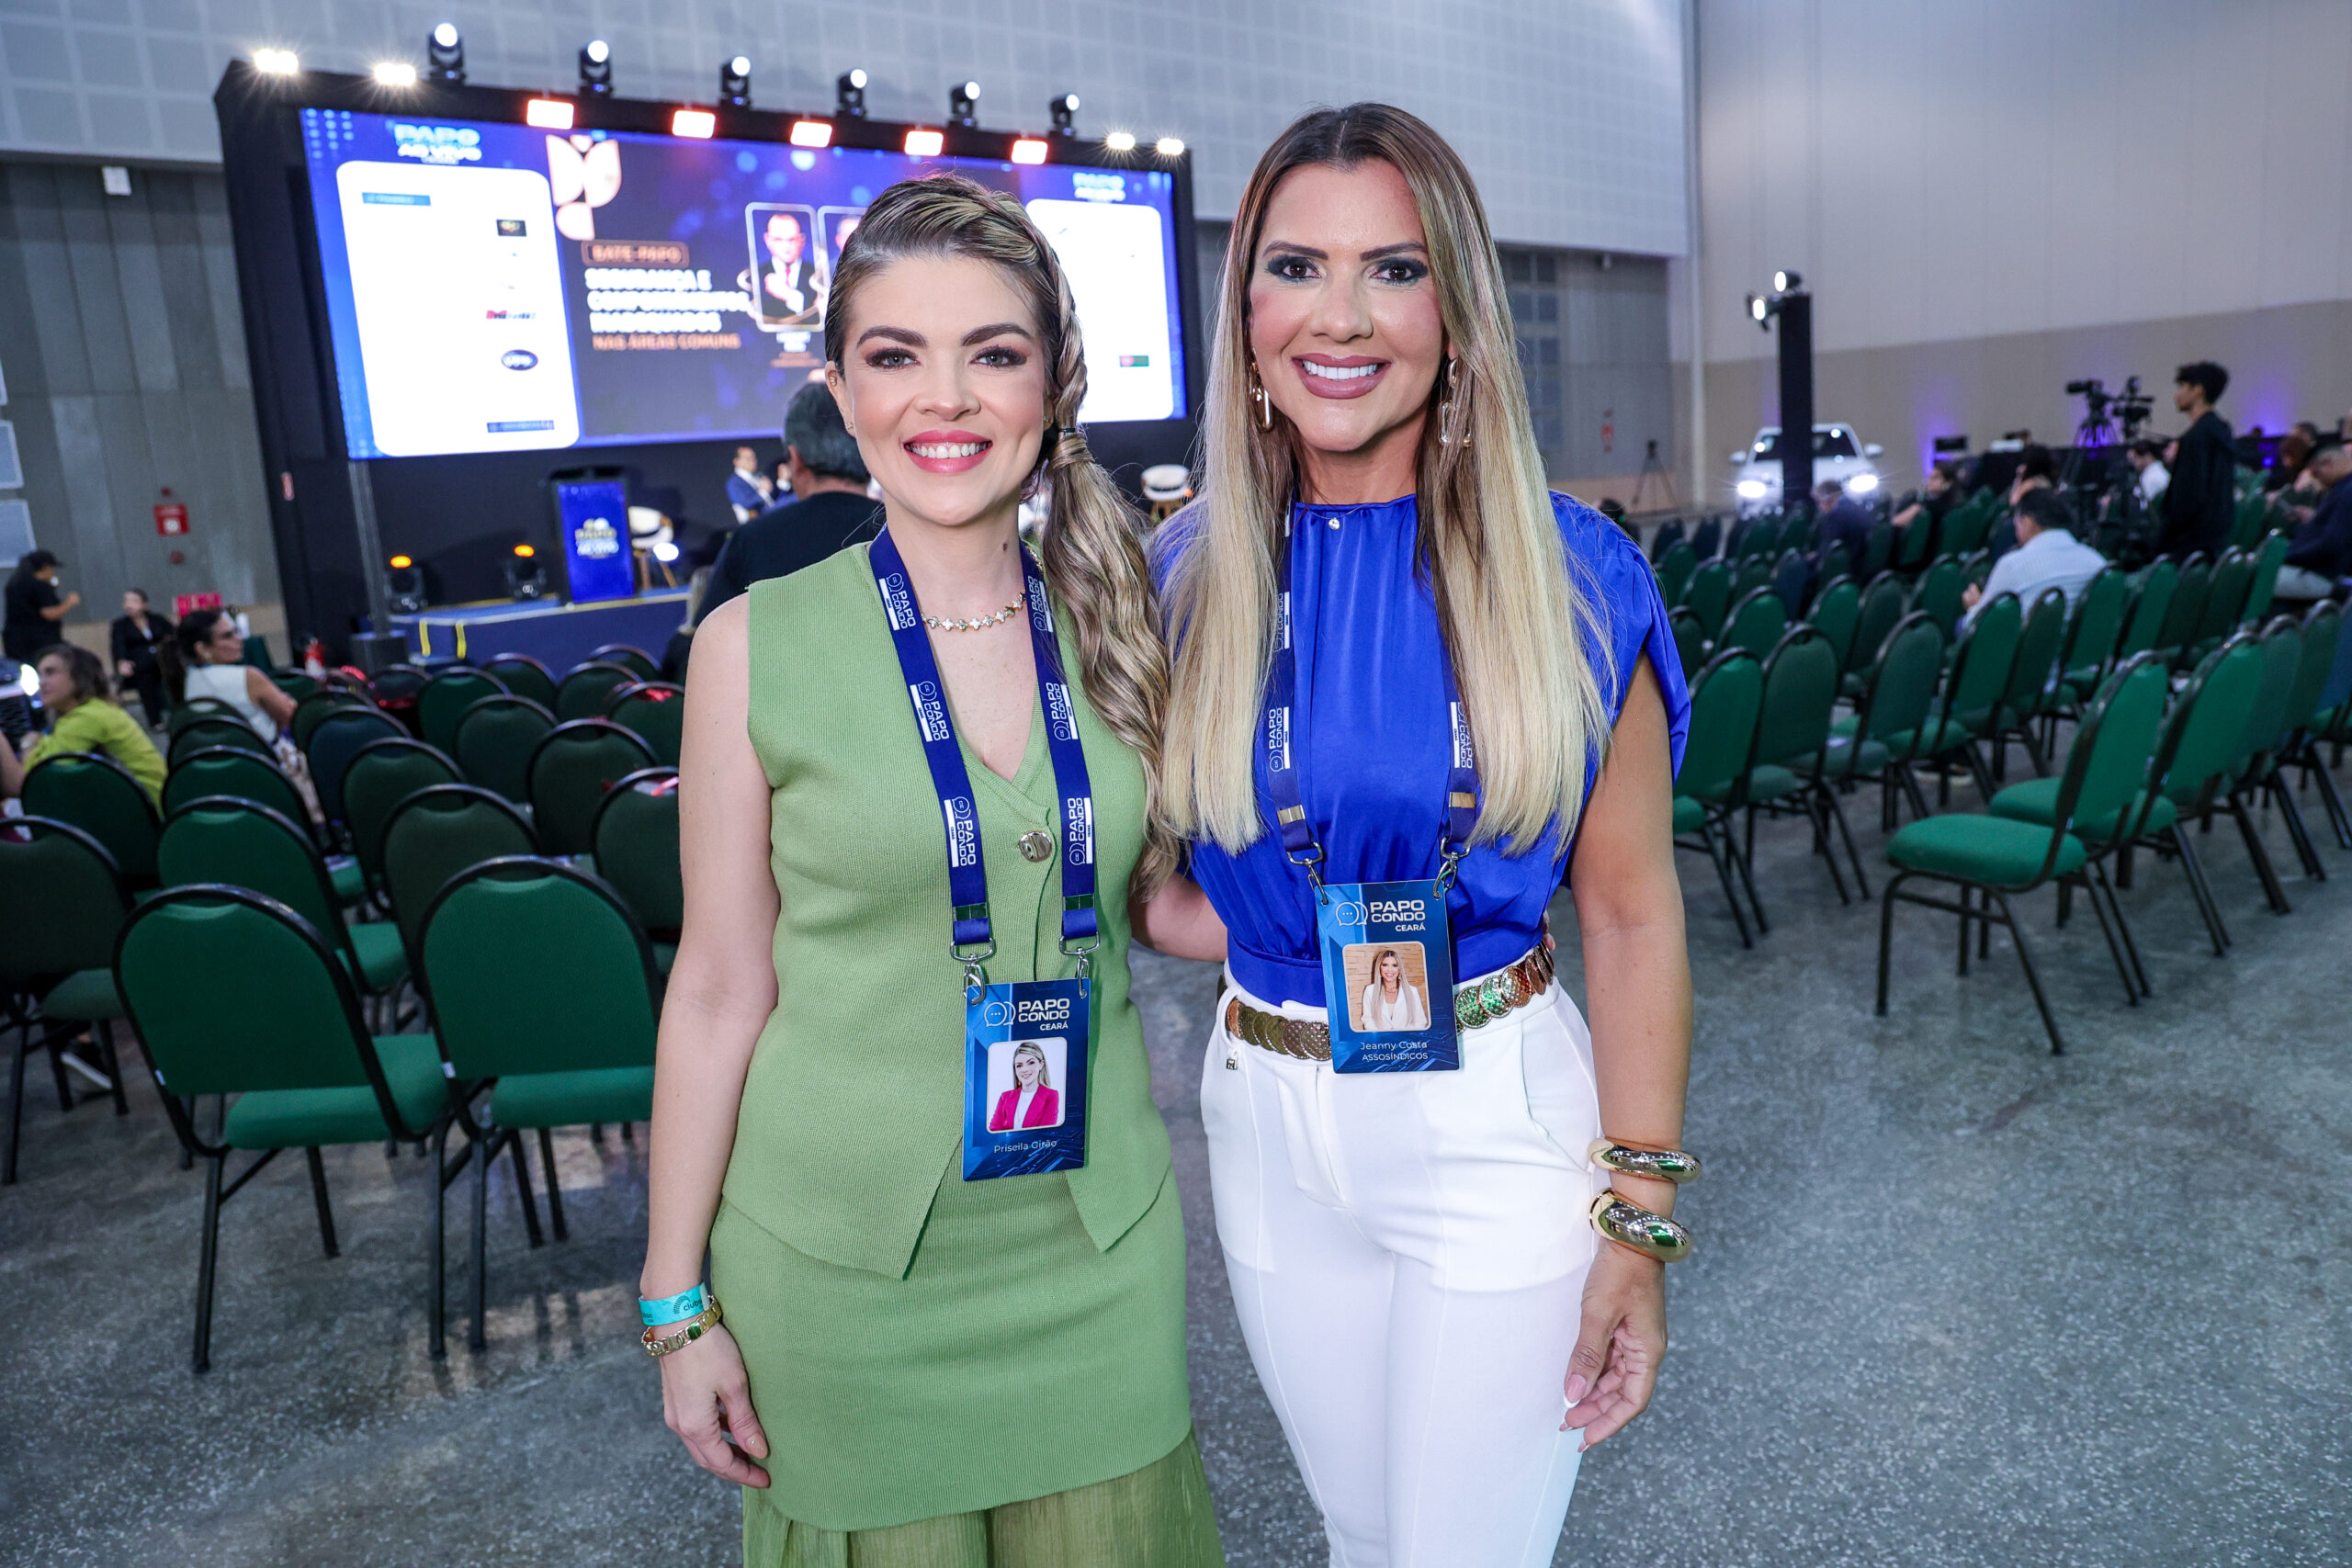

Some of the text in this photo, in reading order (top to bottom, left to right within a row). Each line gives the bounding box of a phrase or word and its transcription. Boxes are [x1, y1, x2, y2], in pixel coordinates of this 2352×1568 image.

[891, 593, 908, 629] CONDO
[898, 590, 916, 627] PAPO
[1027, 575, 1038, 611] PAPO
[1033, 578, 1044, 613] CONDO
[1046, 682, 1060, 720] PAPO
[1053, 683, 1067, 720] CONDO
[923, 703, 941, 741] CONDO
[931, 701, 950, 739] PAPO
[1068, 797, 1078, 842] PAPO
[1076, 797, 1084, 841] CONDO
[956, 821, 967, 866] CONDO
[964, 819, 977, 865] PAPO
[1370, 900, 1425, 913] PAPO
[1371, 911, 1426, 923] CONDO
[1395, 922, 1426, 932] CEARÁ
[1018, 998, 1070, 1013] PAPO
[1018, 1010, 1070, 1022] CONDO
[1039, 1020, 1069, 1031] CEARÁ
[1360, 1041, 1428, 1051] Jeanny Costa
[1362, 1052, 1429, 1061] ASSOSÍNDICOS
[1031, 1139, 1057, 1149] Girão
